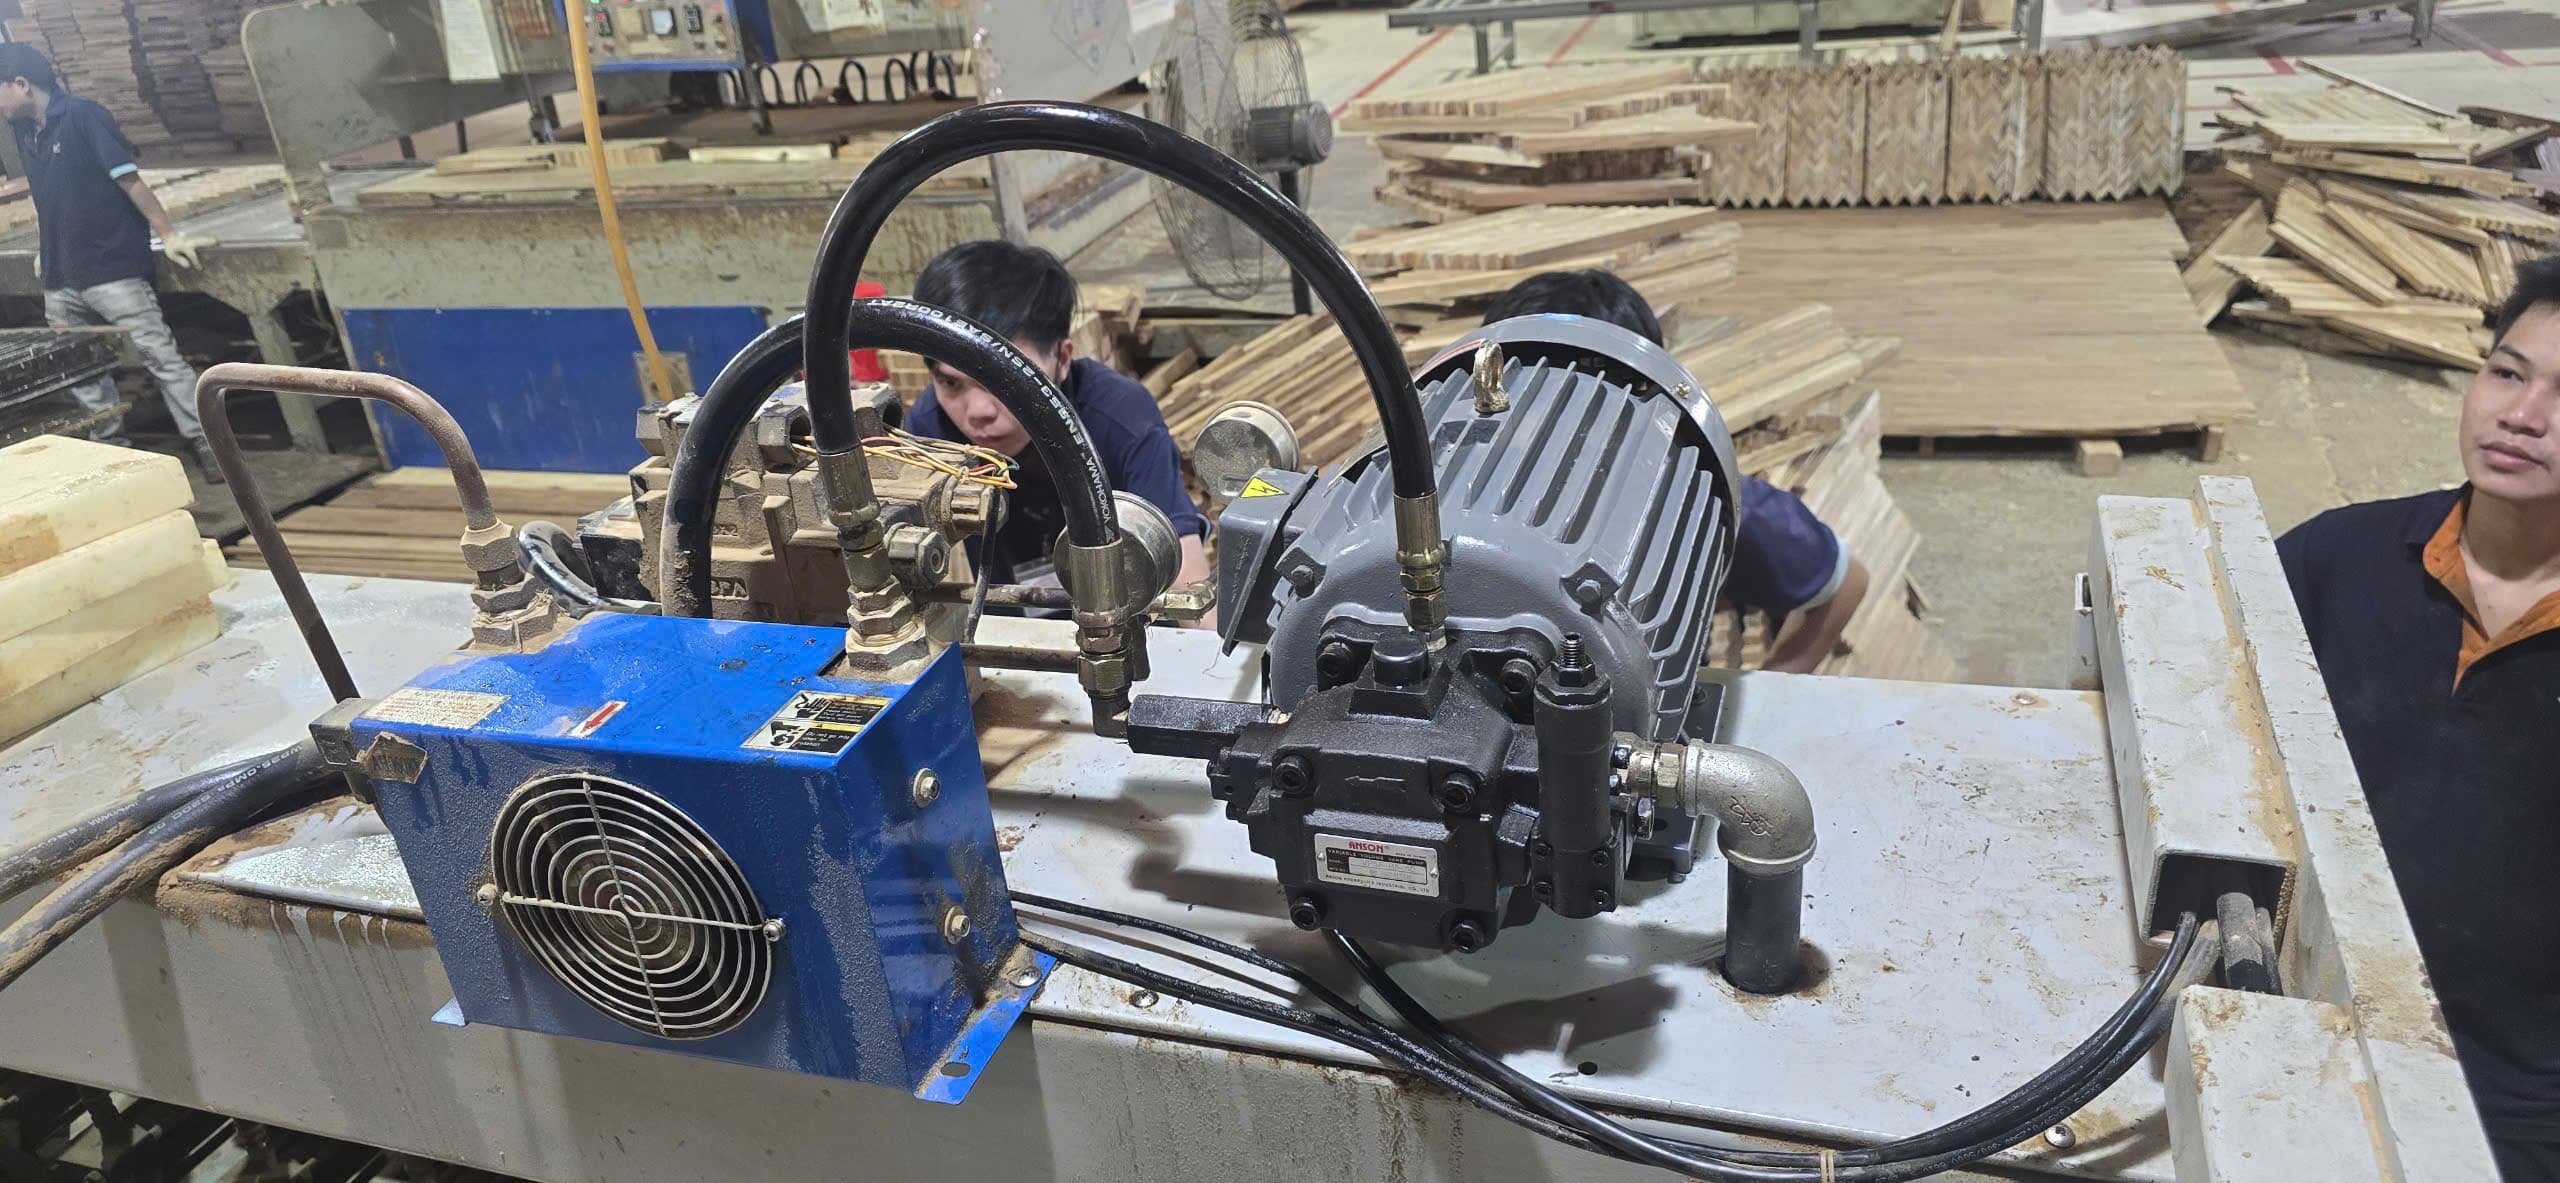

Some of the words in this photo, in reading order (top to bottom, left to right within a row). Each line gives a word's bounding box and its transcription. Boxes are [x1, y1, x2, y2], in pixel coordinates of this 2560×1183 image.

[1087, 456, 1111, 524] YOKOHAMA
[1328, 849, 1357, 857] VARIABLE
[1348, 841, 1384, 853] ANSON
